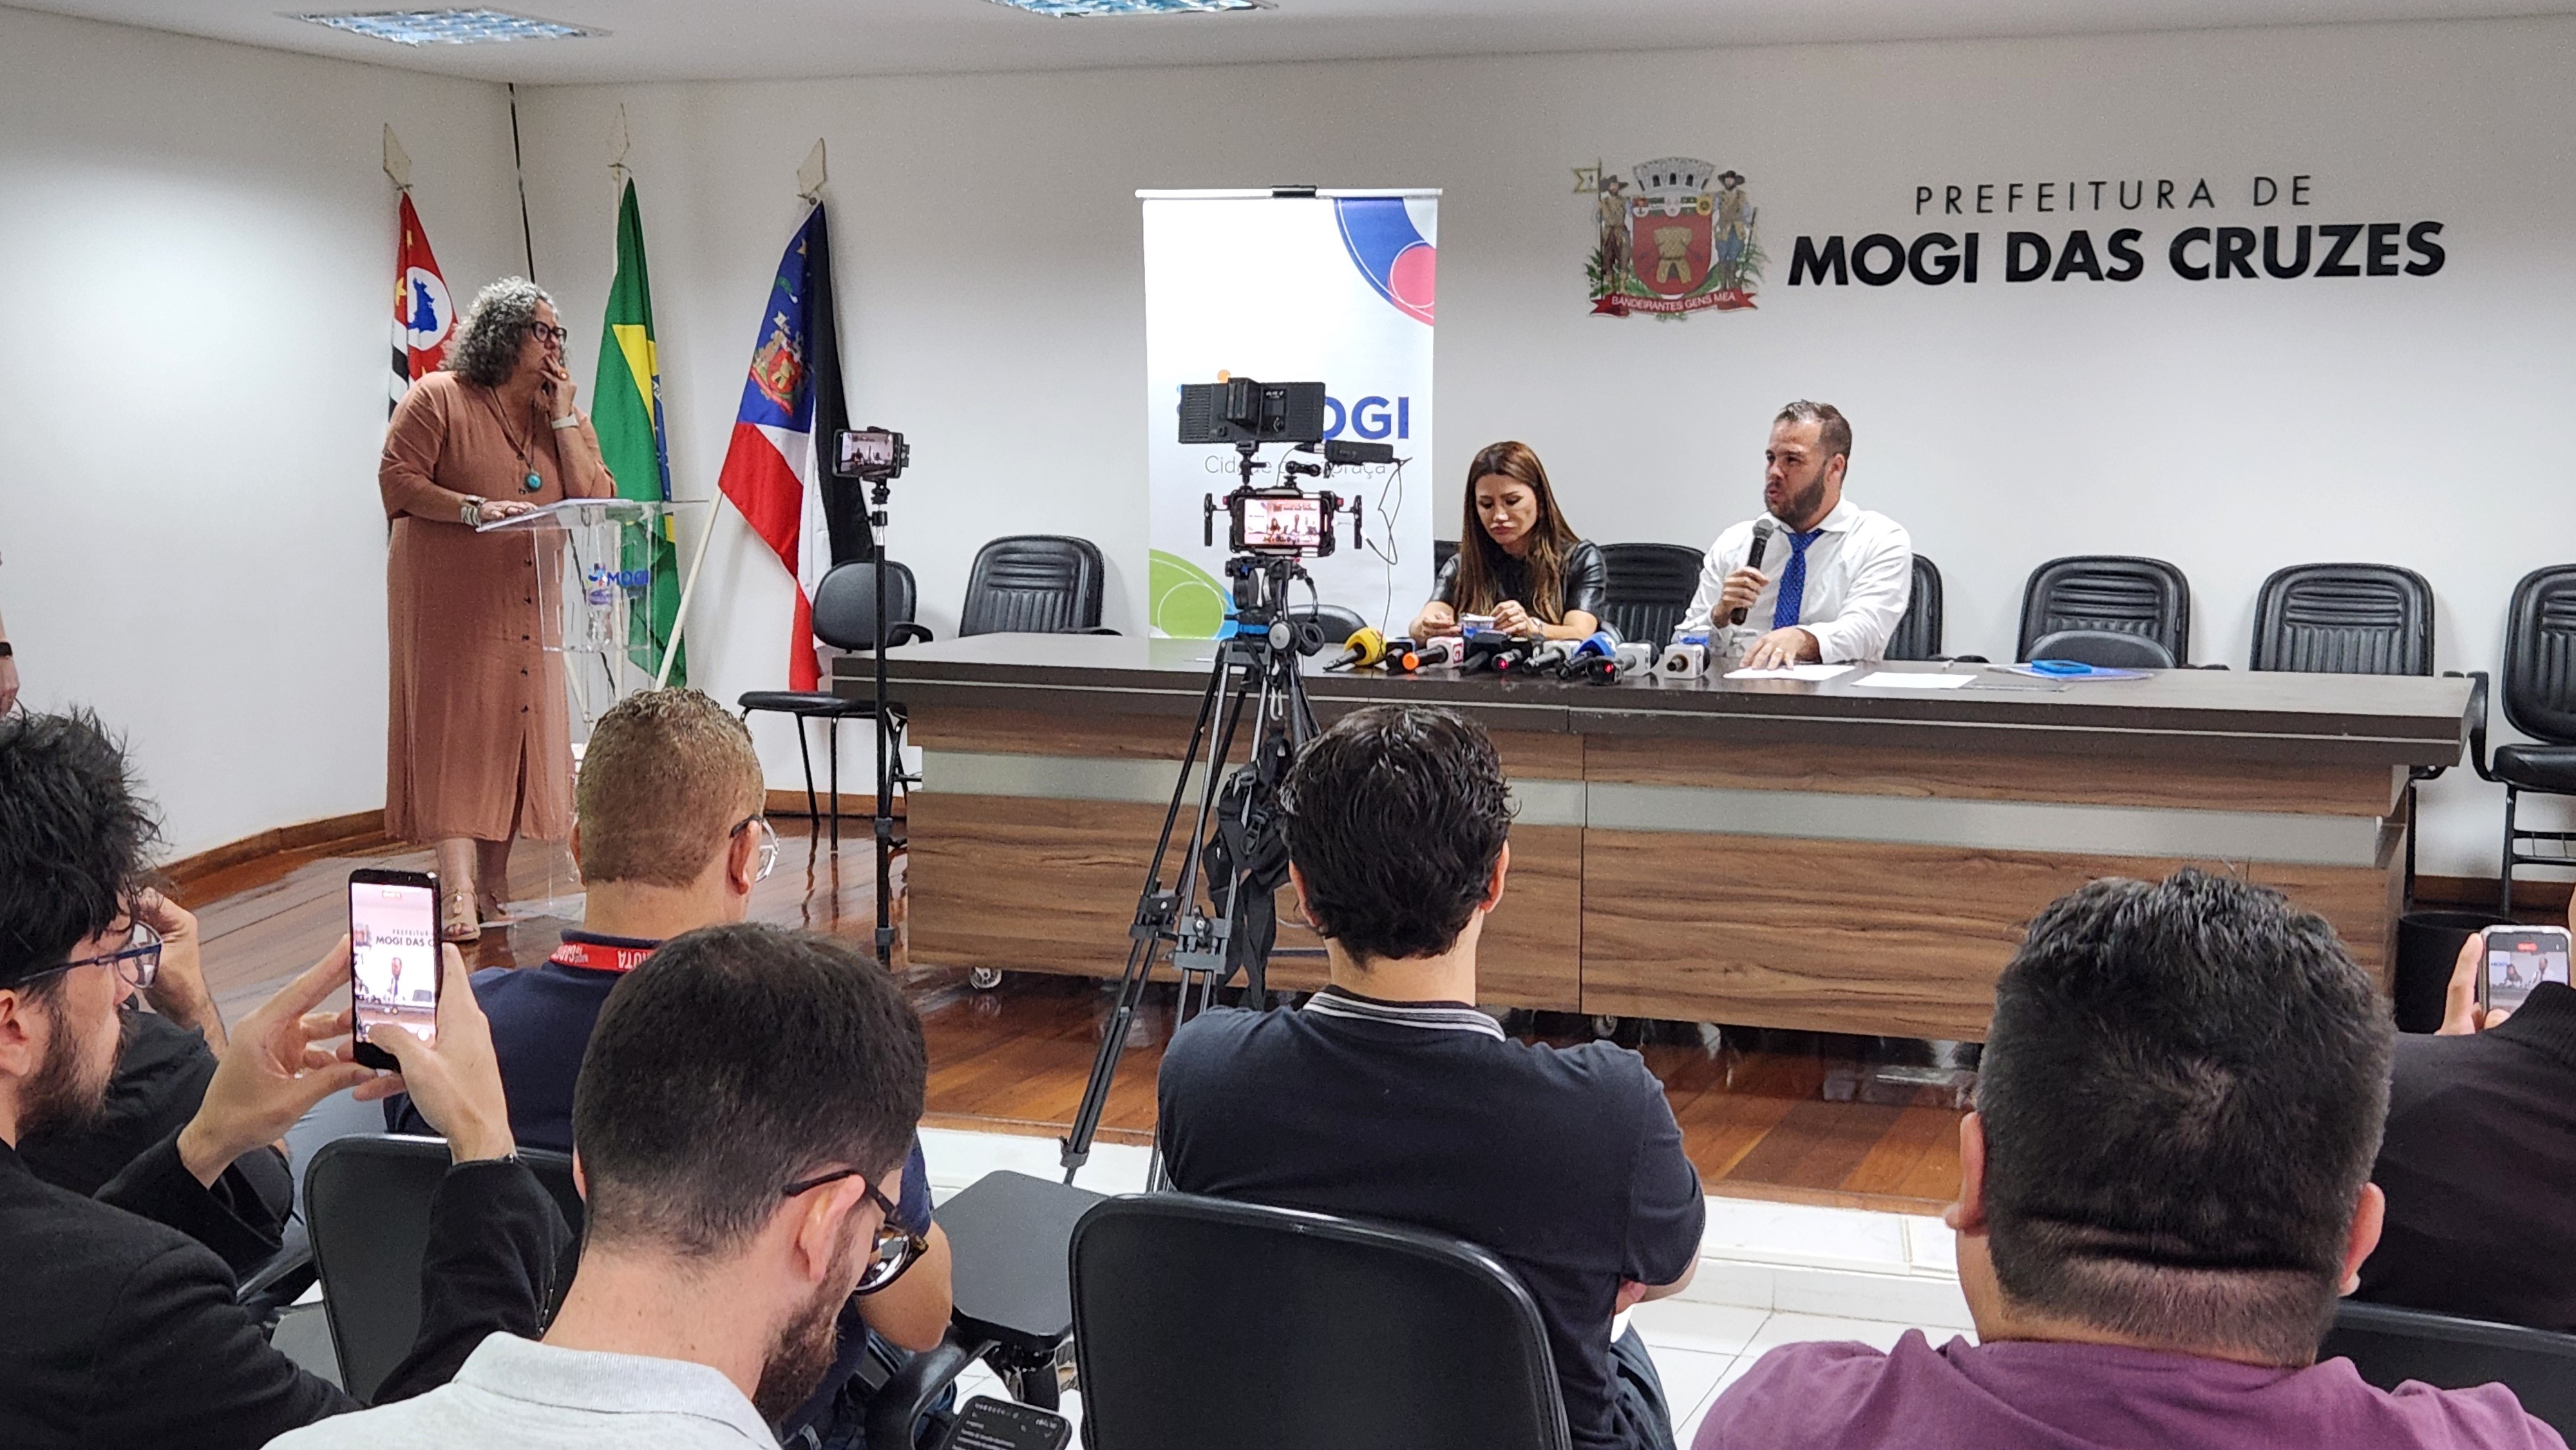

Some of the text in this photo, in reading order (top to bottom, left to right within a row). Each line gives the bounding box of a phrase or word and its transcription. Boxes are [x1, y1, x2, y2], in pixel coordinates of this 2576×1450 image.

[1917, 174, 2311, 215] PREFEITURA DE
[1788, 221, 2445, 285] MOGI DAS CRUZES
[1611, 292, 1736, 312] BANDEIRANTES GENS MEA
[1323, 396, 1409, 440] OGI
[376, 936, 402, 945] MOGI
[406, 937, 424, 946] DAS
